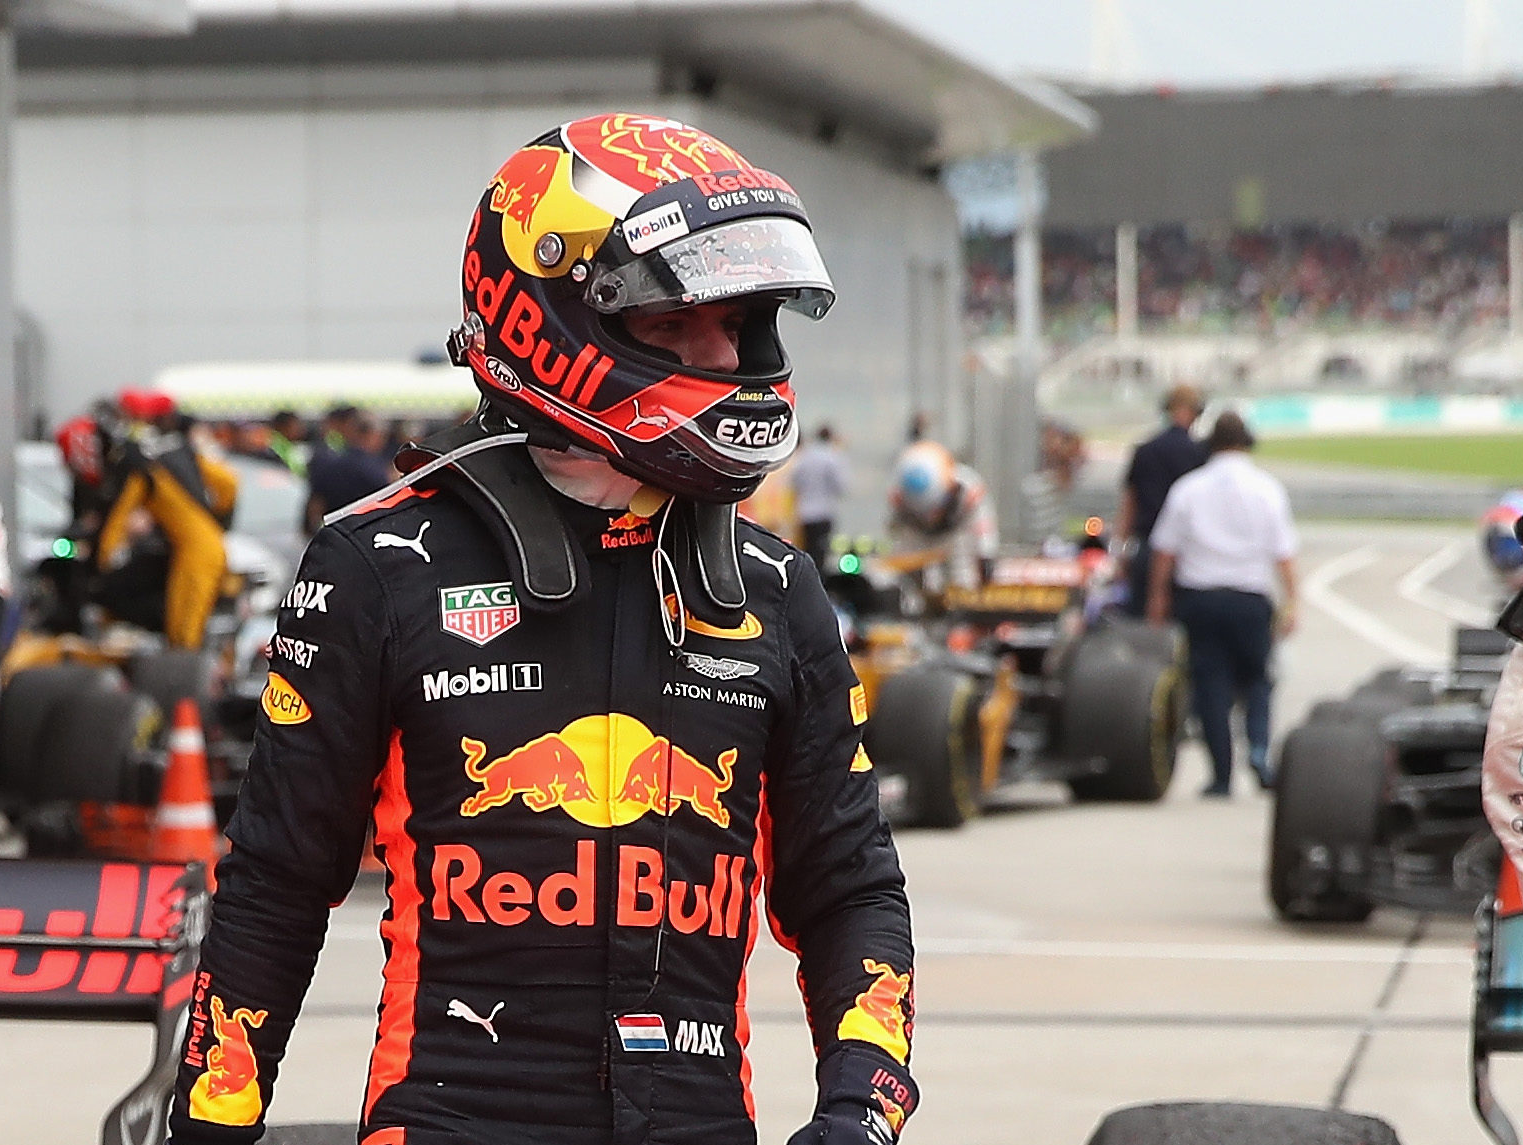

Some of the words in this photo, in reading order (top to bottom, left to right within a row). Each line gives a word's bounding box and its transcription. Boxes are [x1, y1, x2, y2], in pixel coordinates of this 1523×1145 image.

[708, 192, 749, 211] GIVES
[750, 190, 775, 205] YOU
[628, 219, 669, 243] Mobil
[499, 288, 615, 408] Bull
[602, 533, 627, 549] Red
[628, 528, 654, 545] Bull
[449, 587, 512, 609] TAG
[447, 609, 515, 642] HEUER
[276, 635, 319, 669] AT&T
[423, 665, 508, 702] Mobil
[663, 682, 711, 701] ASTON
[717, 690, 767, 711] MARTIN
[431, 840, 597, 927] Red
[616, 845, 747, 939] Bull
[675, 1020, 726, 1058] MAX
